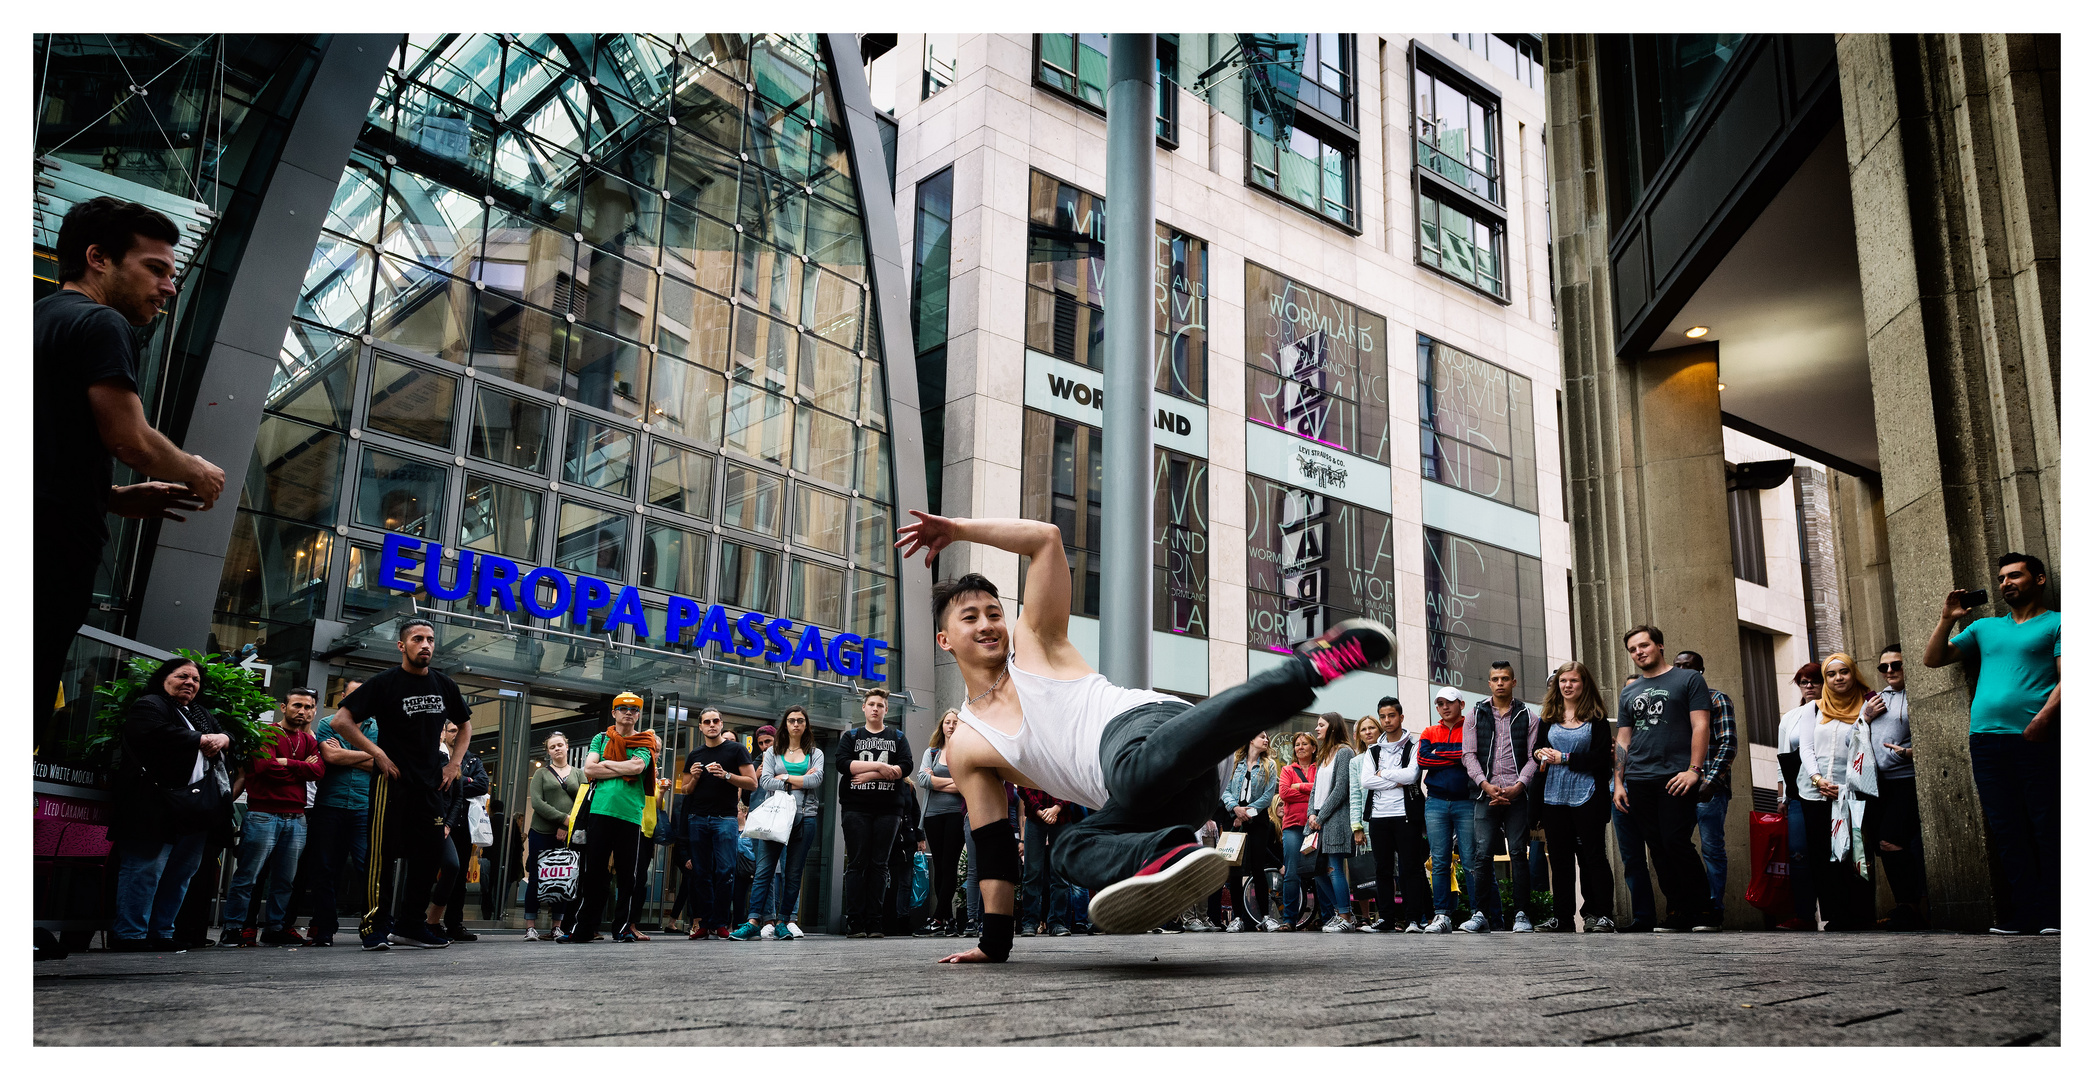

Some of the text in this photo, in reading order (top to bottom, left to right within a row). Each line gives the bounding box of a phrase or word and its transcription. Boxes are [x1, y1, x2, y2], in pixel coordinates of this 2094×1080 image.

[1269, 298, 1373, 352] WORMLAND
[1298, 445, 1310, 456] LEVI
[1311, 449, 1332, 462] STRAUSS
[378, 532, 889, 682] EUROPA PASSAGE
[854, 739, 896, 753] BROOKLYN
[540, 866, 573, 878] KULT
